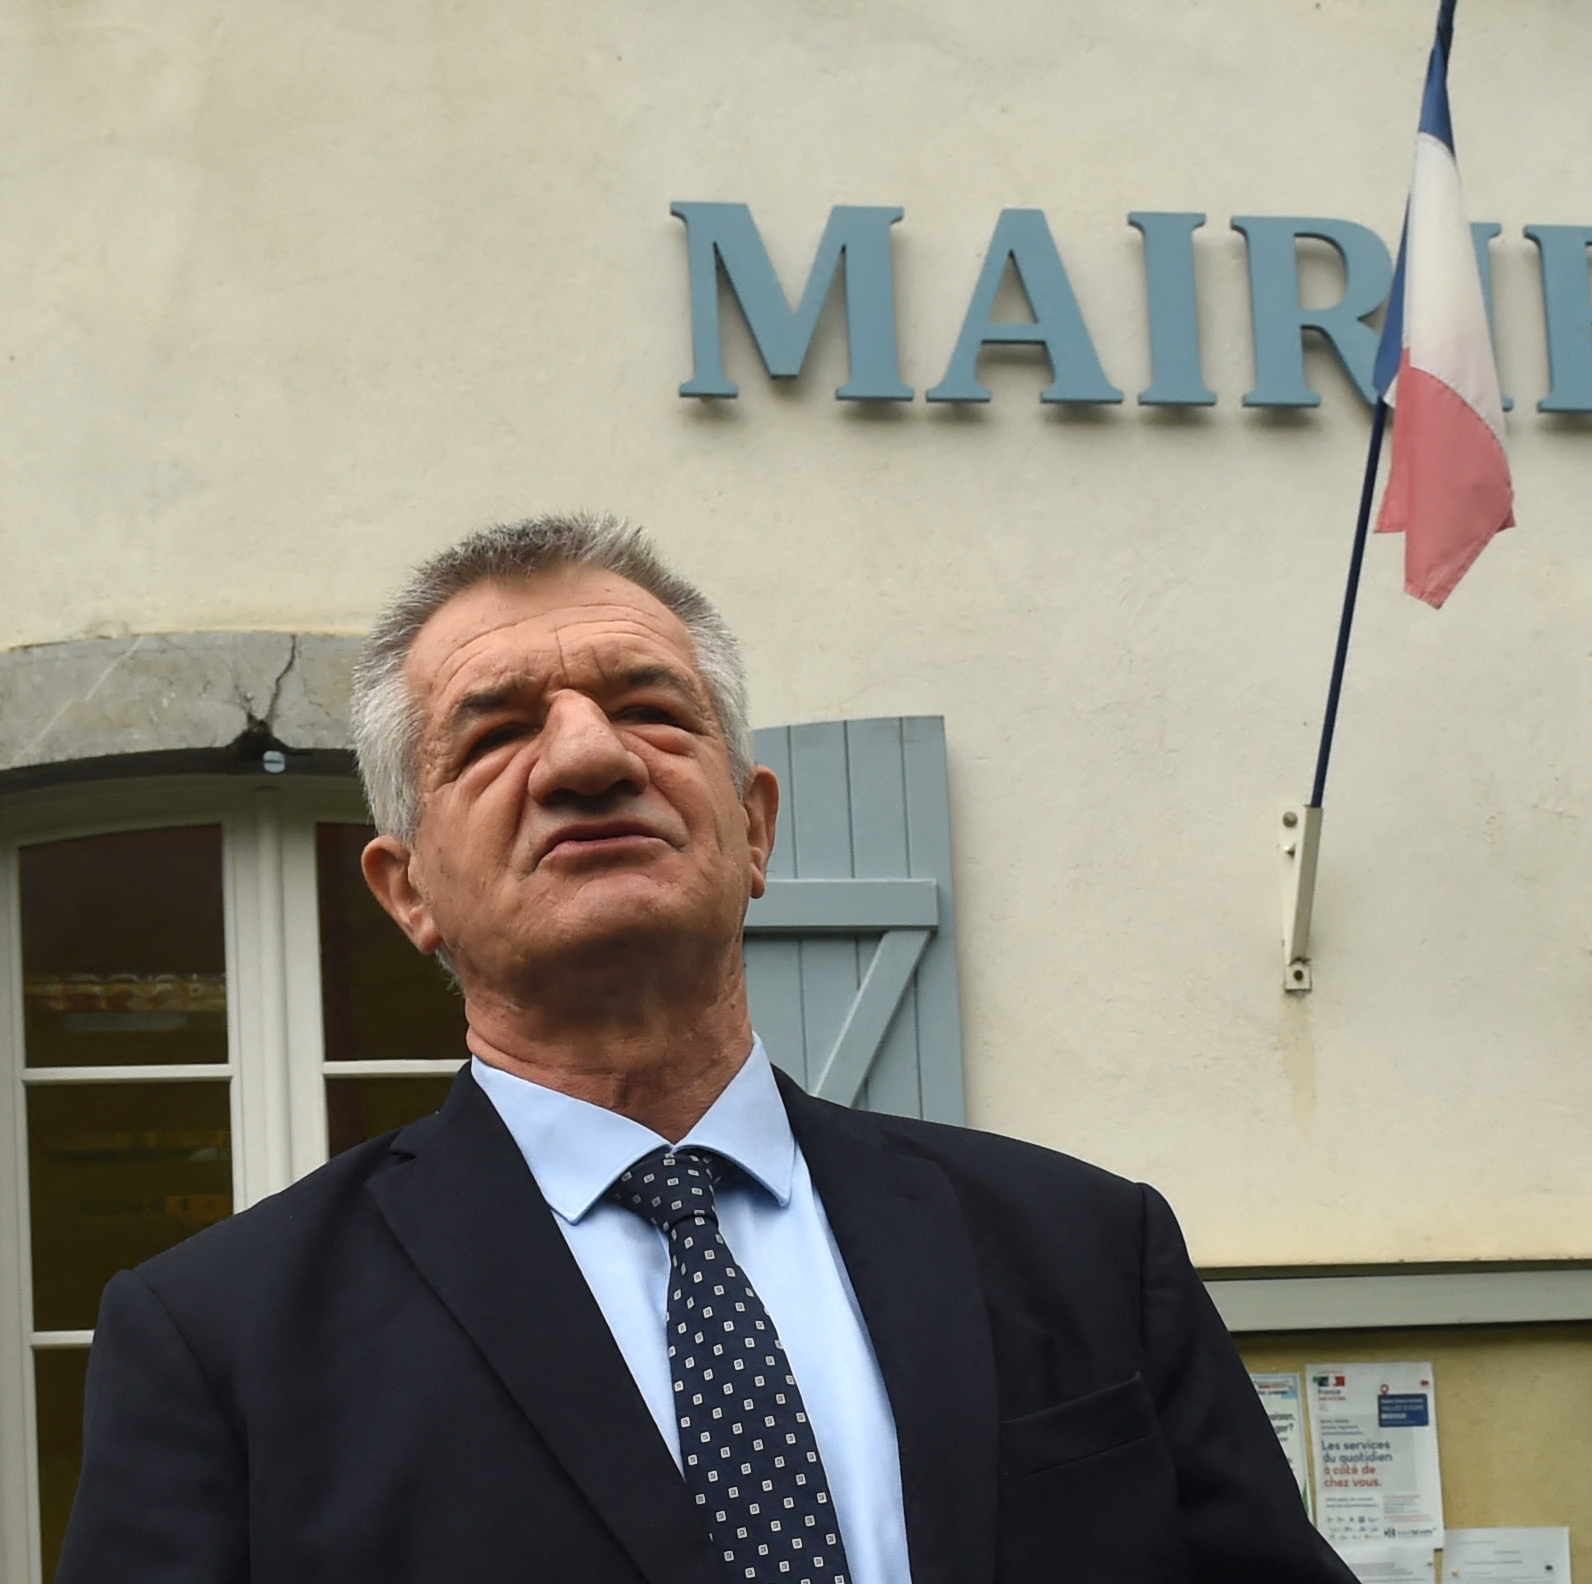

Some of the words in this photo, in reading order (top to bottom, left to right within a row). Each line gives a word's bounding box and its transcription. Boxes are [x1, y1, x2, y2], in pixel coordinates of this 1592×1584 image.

[1321, 1440, 1340, 1451] Les
[1344, 1439, 1391, 1450] services
[1322, 1452, 1336, 1463] du
[1339, 1451, 1393, 1465] quotidien
[1333, 1464, 1359, 1475] côté
[1361, 1464, 1376, 1475] de
[1324, 1477, 1349, 1487] chez
[1352, 1478, 1382, 1487] vous.
